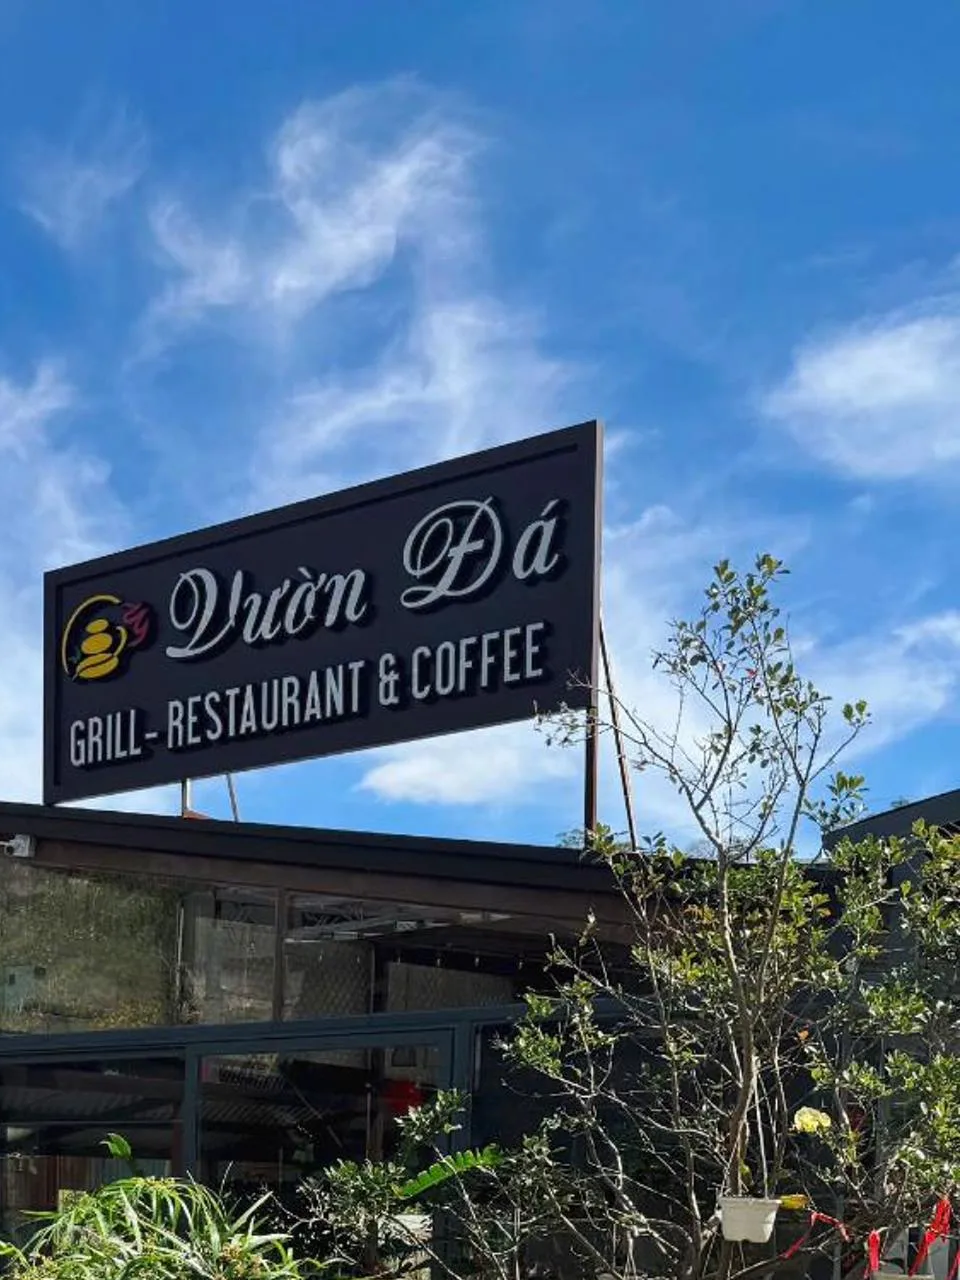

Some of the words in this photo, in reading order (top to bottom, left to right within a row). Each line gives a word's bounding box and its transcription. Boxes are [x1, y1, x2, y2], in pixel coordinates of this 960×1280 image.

[165, 565, 368, 659] Vườn
[399, 496, 560, 609] Đá
[166, 660, 366, 749] RESTAURANT
[378, 652, 400, 707] &
[410, 622, 545, 700] COFFEE
